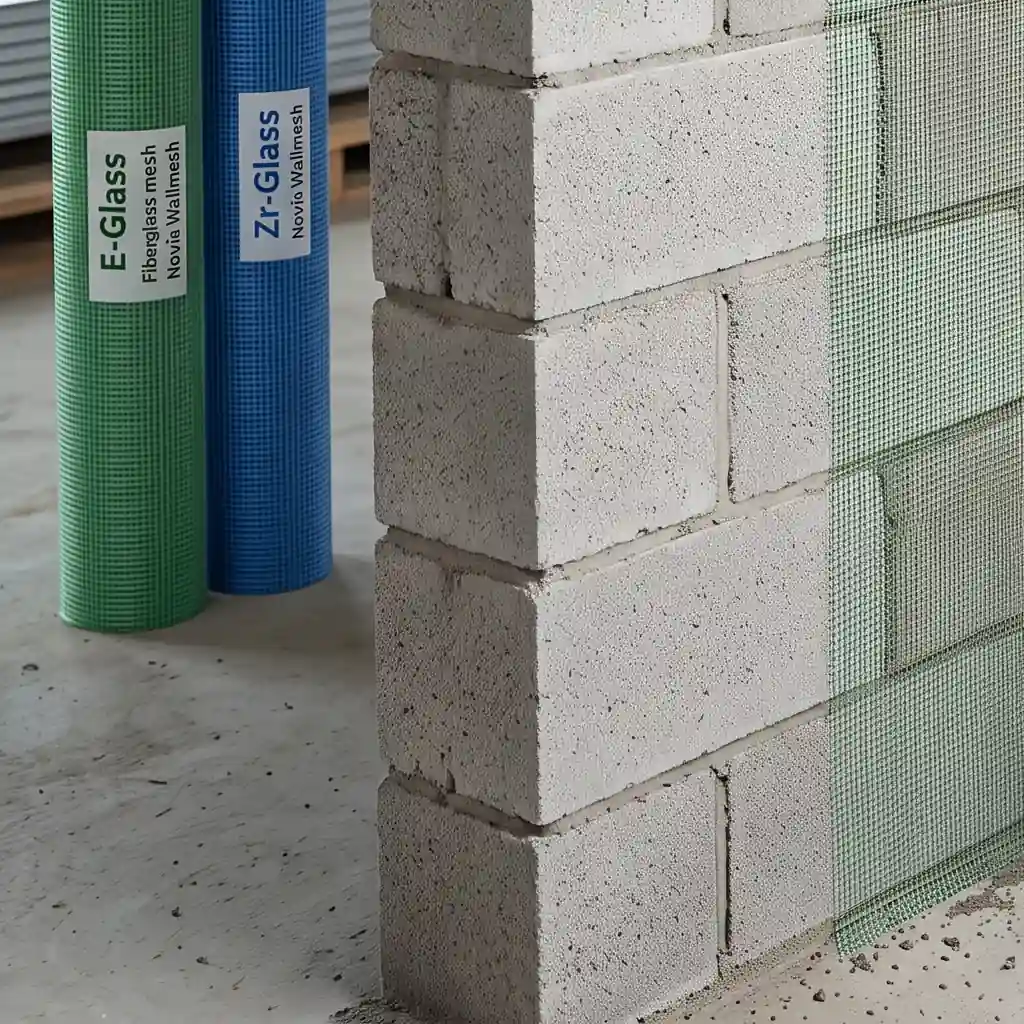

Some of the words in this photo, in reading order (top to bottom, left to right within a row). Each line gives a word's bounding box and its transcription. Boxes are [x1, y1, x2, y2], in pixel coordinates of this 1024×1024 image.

[141, 144, 157, 193] mesh
[165, 141, 180, 226] Wallmesh
[253, 110, 280, 239] Zr-Glass
[290, 104, 304, 189] Wallmesh
[98, 153, 127, 271] E-Glass
[142, 197, 160, 283] Fiberglass
